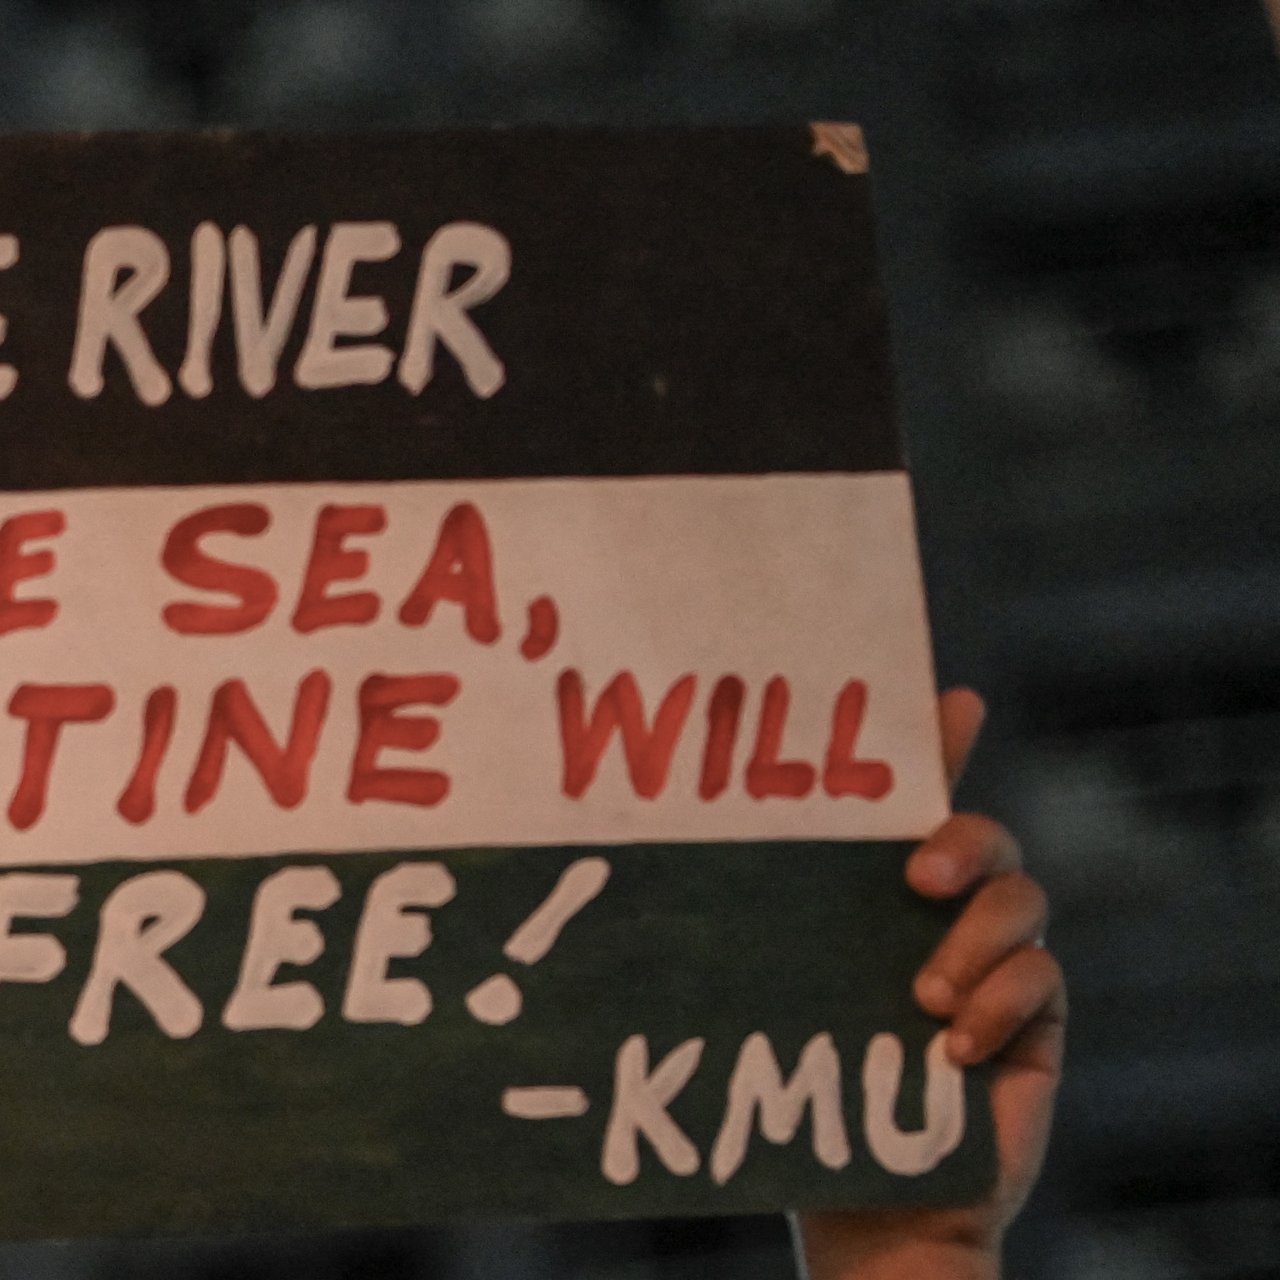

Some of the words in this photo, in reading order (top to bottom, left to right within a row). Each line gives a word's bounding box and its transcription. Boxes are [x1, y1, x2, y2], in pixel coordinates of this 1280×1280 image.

[68, 220, 512, 406] RIVER
[160, 501, 560, 660] SEA,
[557, 669, 895, 801] WILL
